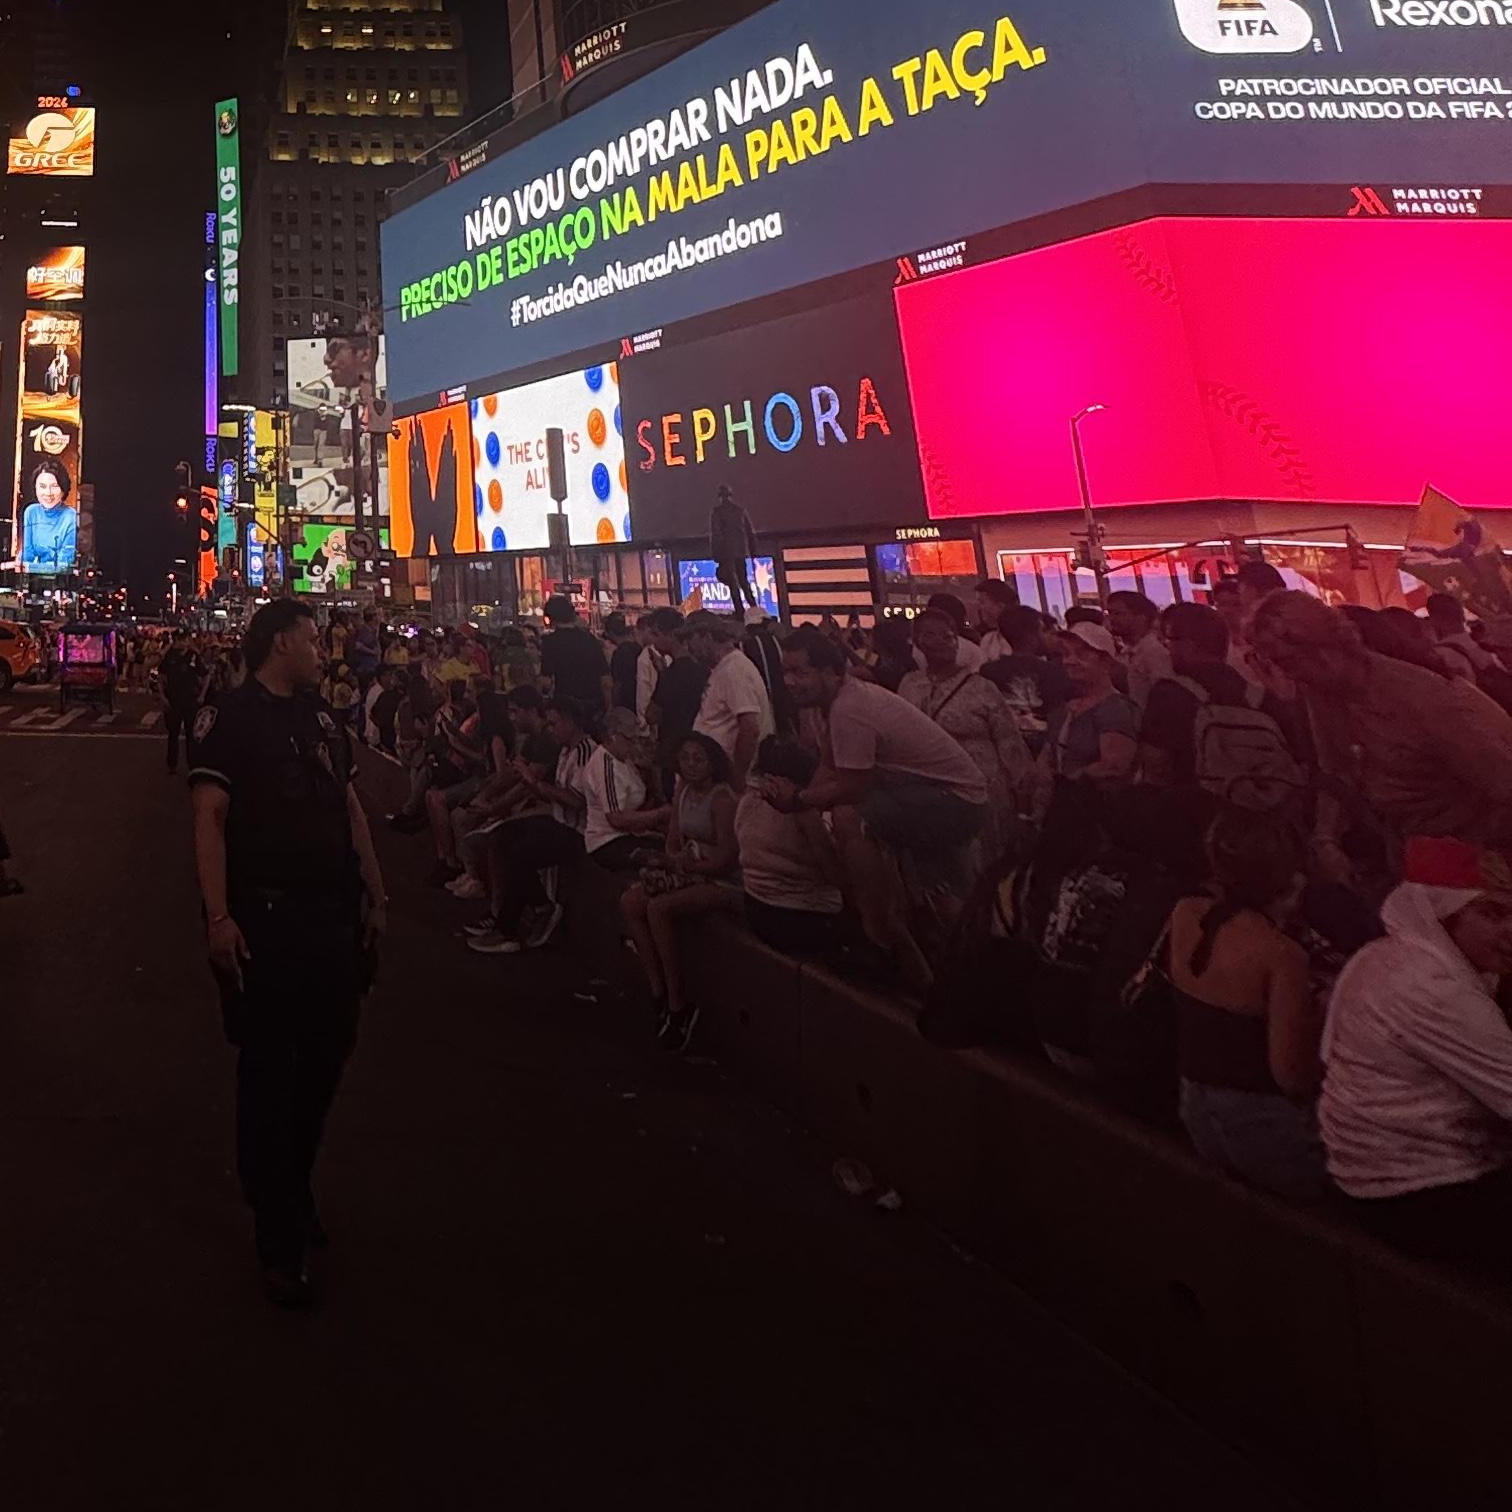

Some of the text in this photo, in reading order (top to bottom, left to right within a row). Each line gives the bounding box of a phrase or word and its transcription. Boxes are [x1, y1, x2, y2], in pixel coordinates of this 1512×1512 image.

[1218, 18, 1279, 37] FIFA
[573, 21, 628, 58] MARRIOTT
[574, 39, 622, 71] MARQUIS
[1218, 77, 1512, 96] PATROCINADOR OFICIAL
[1194, 101, 1264, 120] COPA
[1268, 101, 1302, 120] DO
[1309, 101, 1404, 119] MUNDO
[1406, 101, 1447, 119] DA
[1447, 101, 1504, 119] FIFA
[464, 41, 835, 251] NÃO VOU COMPRAR NADA.
[14, 151, 86, 169] GREE
[400, 15, 1048, 323] PRECISO DE ESPAÇO NA MALA PARA A TAÇA.
[1391, 188, 1482, 201] MARRIOTT
[1394, 201, 1477, 214] MARQUIS
[219, 165, 239, 307] 50 YEARS
[917, 241, 967, 263] MARRIOTT
[509, 210, 784, 328] #TorcidaQueNuncaAbandona
[918, 254, 964, 275] MARQUIS
[637, 377, 892, 473] SEPHORA
[507, 441, 533, 465] THE
[895, 527, 941, 541] SEPHORA
